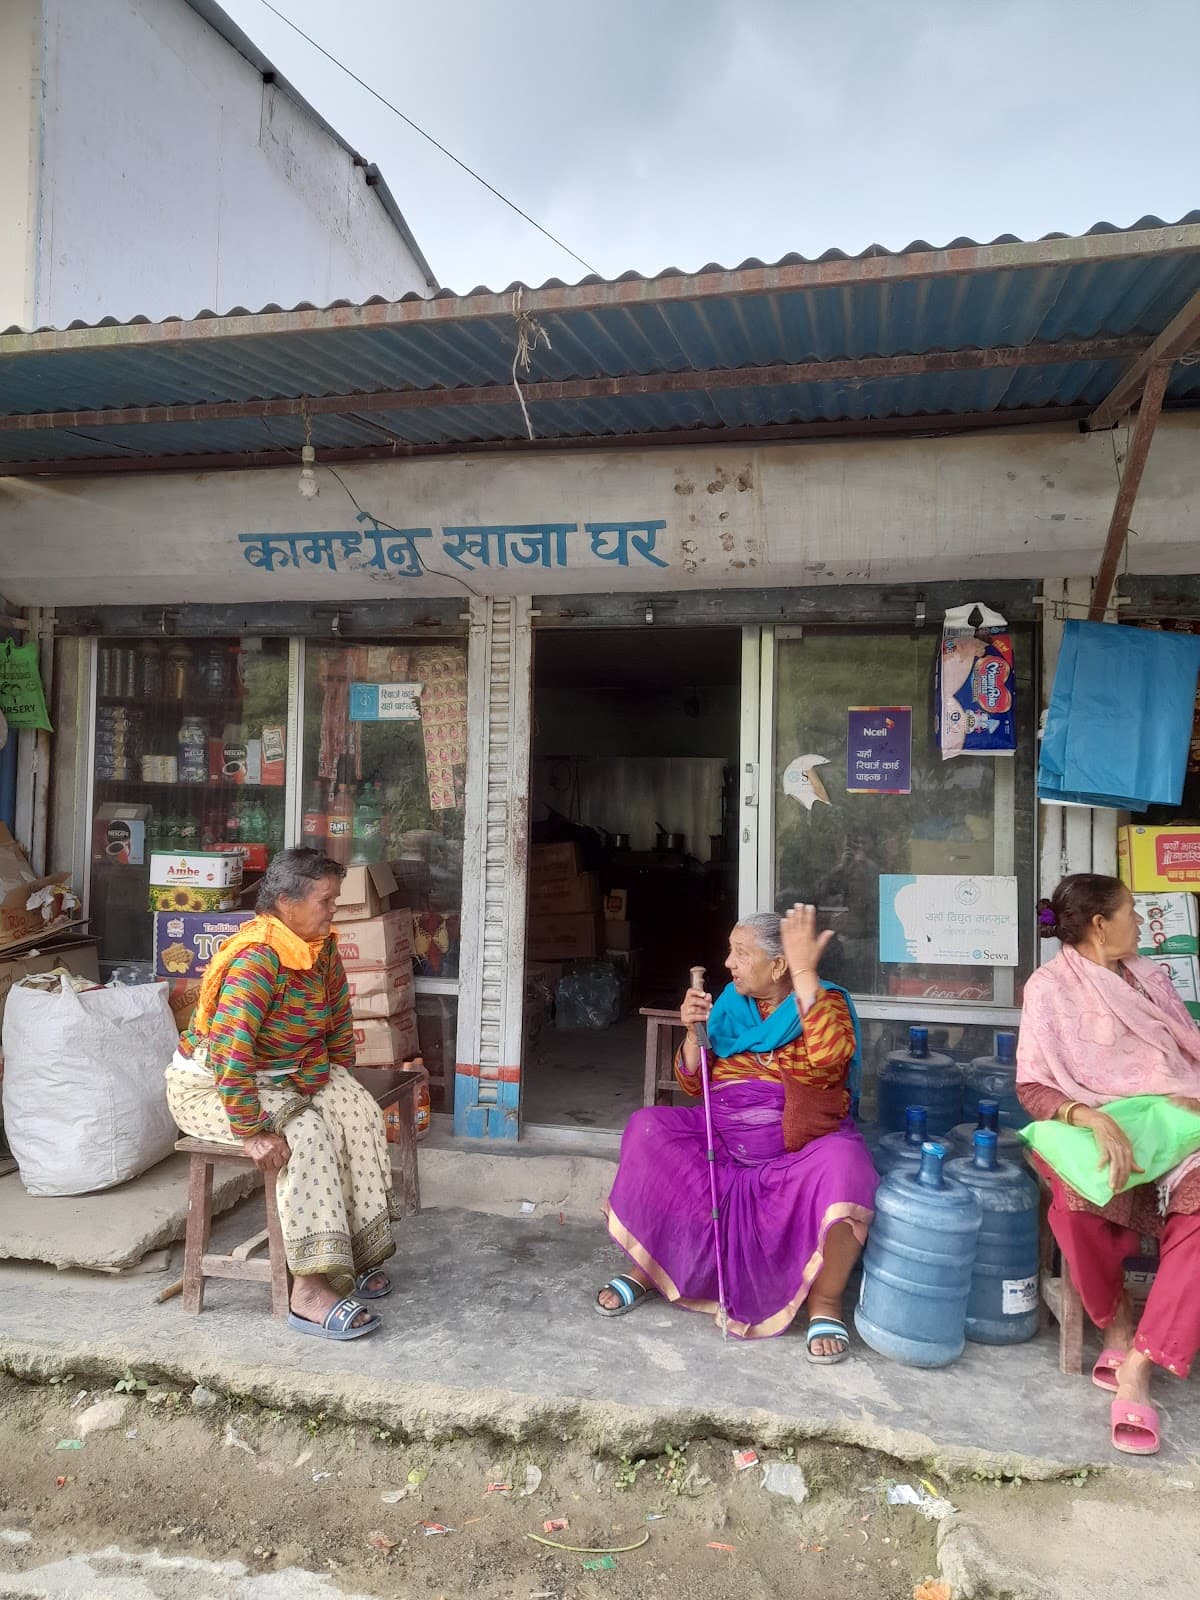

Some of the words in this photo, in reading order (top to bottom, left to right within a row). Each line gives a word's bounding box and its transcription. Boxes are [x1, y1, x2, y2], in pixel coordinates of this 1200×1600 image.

[238, 511, 432, 578] कामधेनु
[442, 523, 577, 571] खाजा
[584, 519, 670, 568] घर
[0, 704, 36, 715] URSERY
[863, 727, 888, 737] Ncell
[167, 865, 200, 877] Ambe
[203, 922, 240, 933] Tradition
